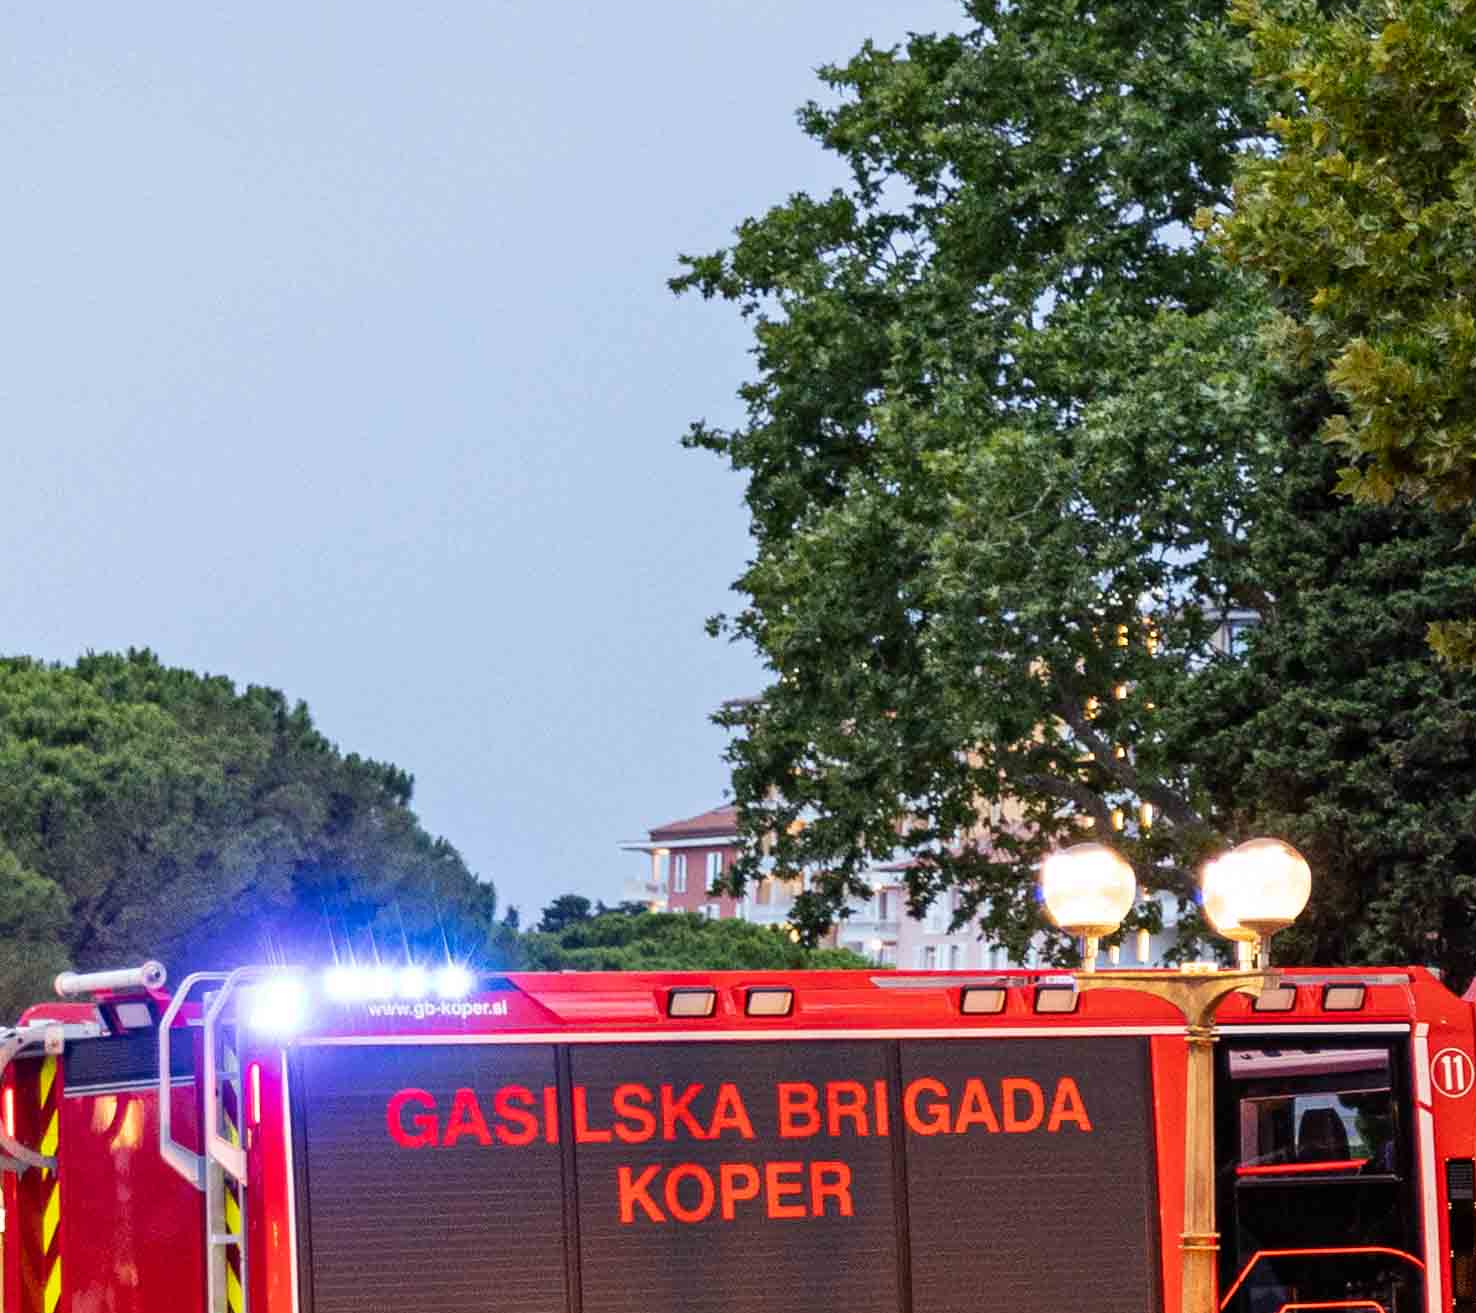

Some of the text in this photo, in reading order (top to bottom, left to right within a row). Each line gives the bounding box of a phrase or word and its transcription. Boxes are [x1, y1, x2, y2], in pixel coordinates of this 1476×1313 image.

[1441, 1055, 1465, 1091] 11
[386, 1075, 1094, 1149] GASILSKA BRIGADA
[615, 1160, 855, 1225] KOPER
